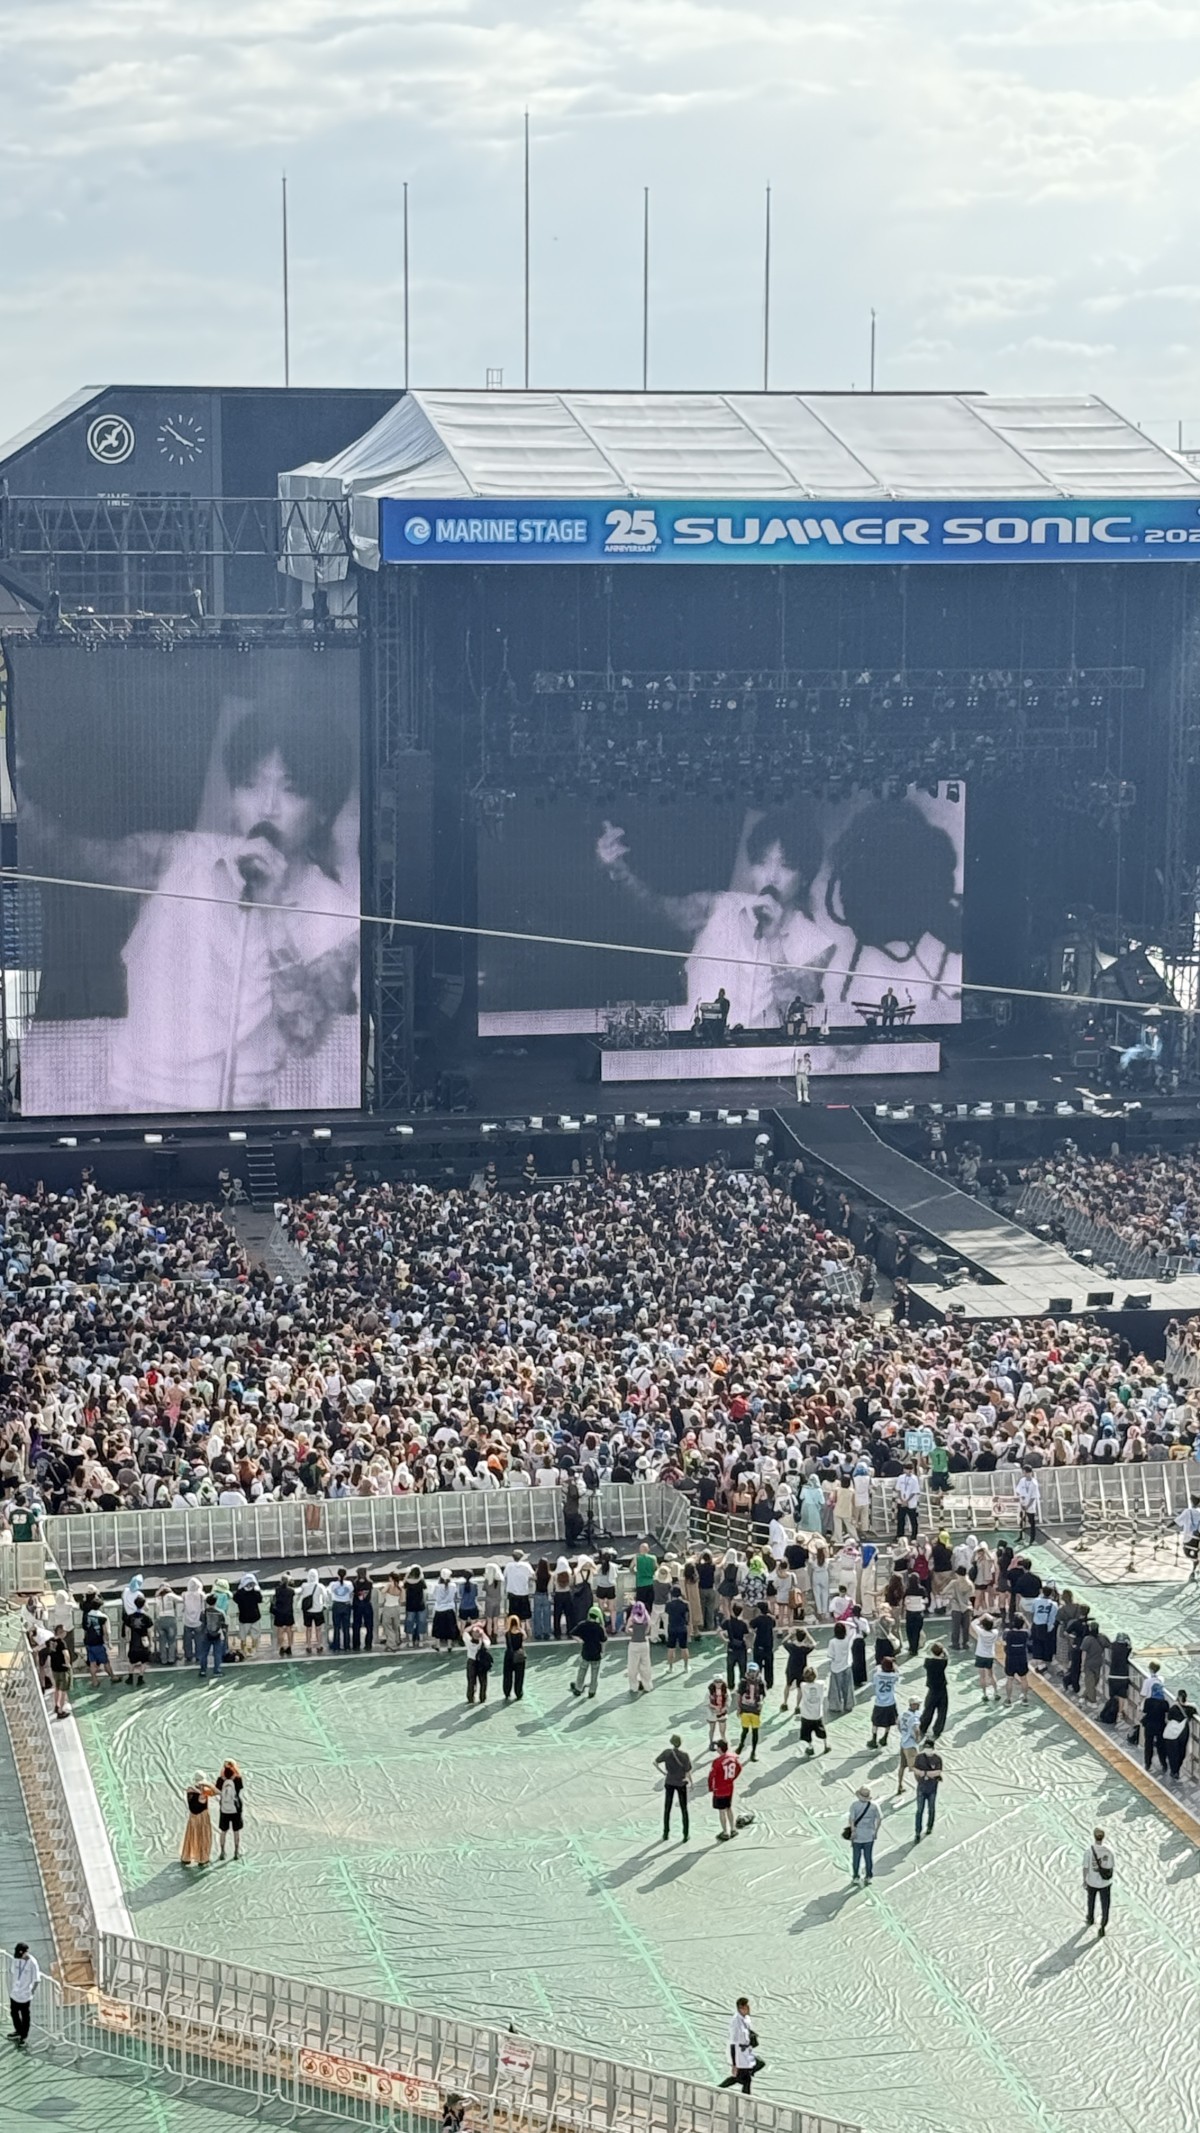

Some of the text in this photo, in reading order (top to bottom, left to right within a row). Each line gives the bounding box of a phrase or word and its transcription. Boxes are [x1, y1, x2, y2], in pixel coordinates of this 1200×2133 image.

[436, 518, 587, 543] MARINE STAGE
[605, 509, 657, 545] 25
[673, 517, 930, 545] SUMMER
[943, 516, 1132, 544] SONIC
[878, 1680, 893, 1693] 25
[722, 1762, 736, 1781] 18
